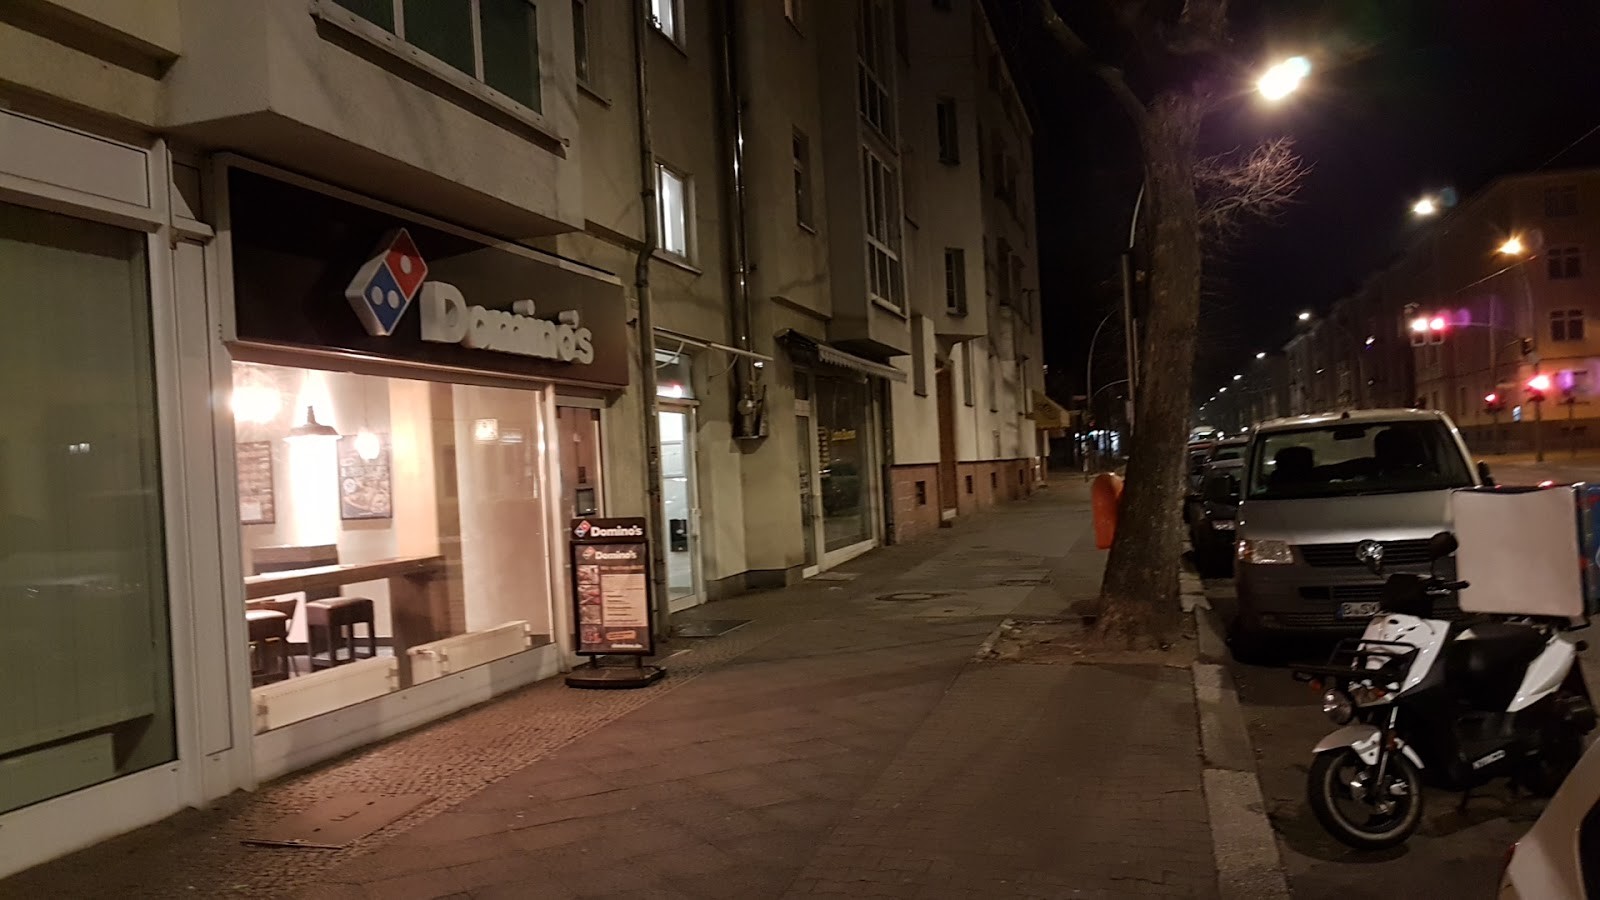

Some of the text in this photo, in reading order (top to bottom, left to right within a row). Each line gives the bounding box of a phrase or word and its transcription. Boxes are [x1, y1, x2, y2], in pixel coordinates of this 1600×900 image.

[419, 280, 595, 365] Domino's
[590, 525, 643, 537] Domino's
[595, 550, 637, 560] Domino's
